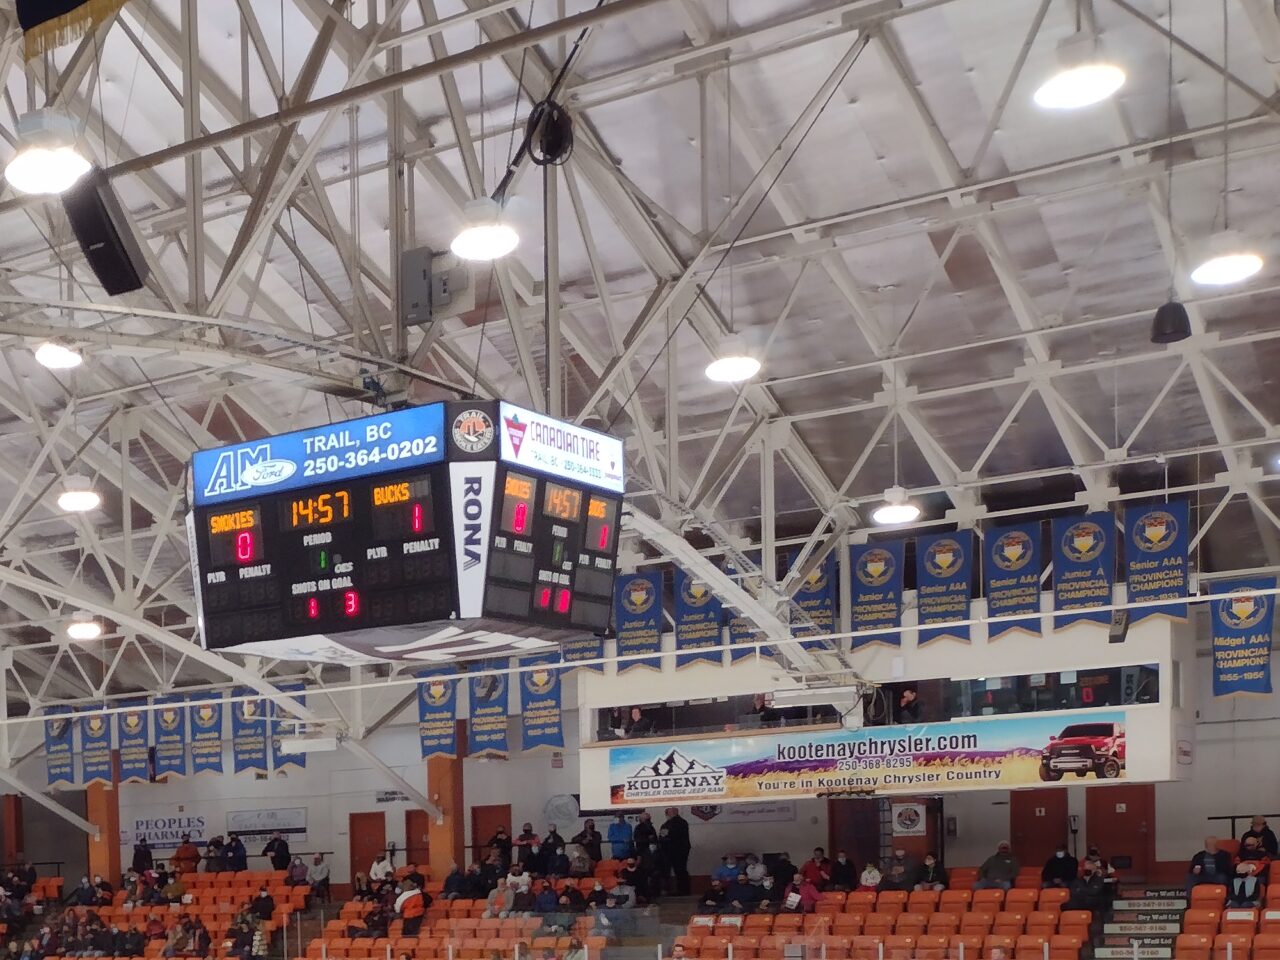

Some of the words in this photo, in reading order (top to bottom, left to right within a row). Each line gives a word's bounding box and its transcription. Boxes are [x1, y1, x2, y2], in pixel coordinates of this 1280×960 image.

[303, 431, 360, 454] TRAIL,
[366, 422, 392, 442] BC
[531, 421, 578, 455] CANADIAN
[581, 437, 600, 461] TIRE
[303, 436, 437, 477] 250-364-0202
[204, 444, 271, 497] AM
[252, 464, 284, 482] Ford
[373, 482, 410, 505] BUCKS
[292, 490, 350, 526] 14:57
[211, 510, 254, 533] SMOKIES
[413, 503, 422, 532] 1
[463, 476, 482, 571] RONA
[237, 531, 252, 560] 0
[303, 532, 332, 546] PERIOD
[403, 538, 440, 554] PENALTY
[320, 550, 327, 568] 1
[1130, 559, 1159, 570] Senior
[1162, 556, 1183, 567] AAA
[239, 564, 271, 579] PENALTY
[1097, 567, 1105, 576] A
[1129, 570, 1184, 583] PROVINCIAL
[1057, 580, 1109, 591] PROVINCIAL
[1059, 587, 1109, 600] CHAMPIONS
[1130, 578, 1183, 592] CHAMPIONS
[308, 598, 318, 618] 1
[345, 591, 358, 615] 3
[1214, 636, 1246, 648] Midget
[1249, 634, 1269, 644] AAA
[777, 732, 977, 761] kootenaychrysler.com
[837, 757, 912, 771] 250-368-8295
[627, 775, 723, 791] KOOTENAY
[757, 780, 795, 791] You're
[801, 779, 812, 788] in
[818, 775, 878, 788] Kootenay
[884, 770, 940, 785] Chrysler
[946, 768, 1001, 782] Country
[626, 789, 661, 798] CHRYSLER
[663, 788, 686, 796] DODGE
[688, 787, 704, 795] JEEP
[136, 816, 205, 830] PEOPLES
